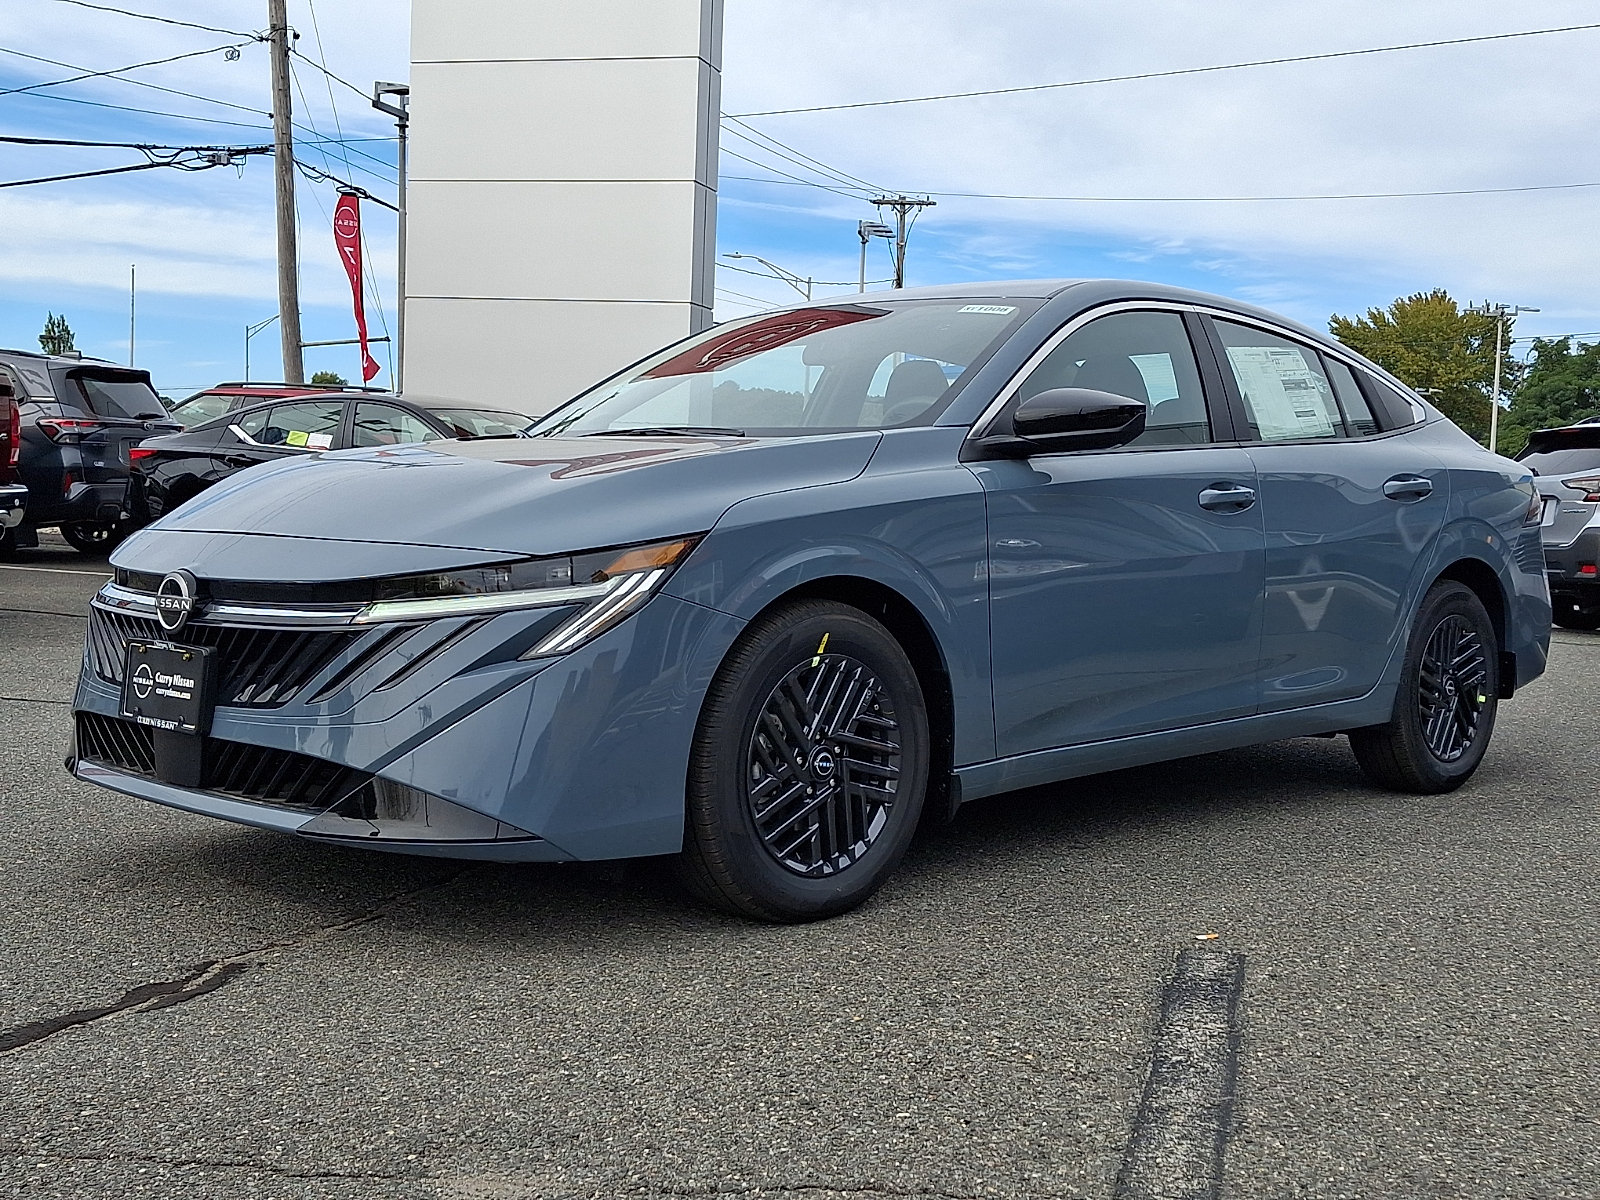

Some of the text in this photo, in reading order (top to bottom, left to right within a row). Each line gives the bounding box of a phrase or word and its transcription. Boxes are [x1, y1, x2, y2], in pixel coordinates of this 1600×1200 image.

[155, 598, 190, 609] SSAN
[133, 676, 153, 685] NISSAN
[155, 672, 194, 688] Curry Nissan
